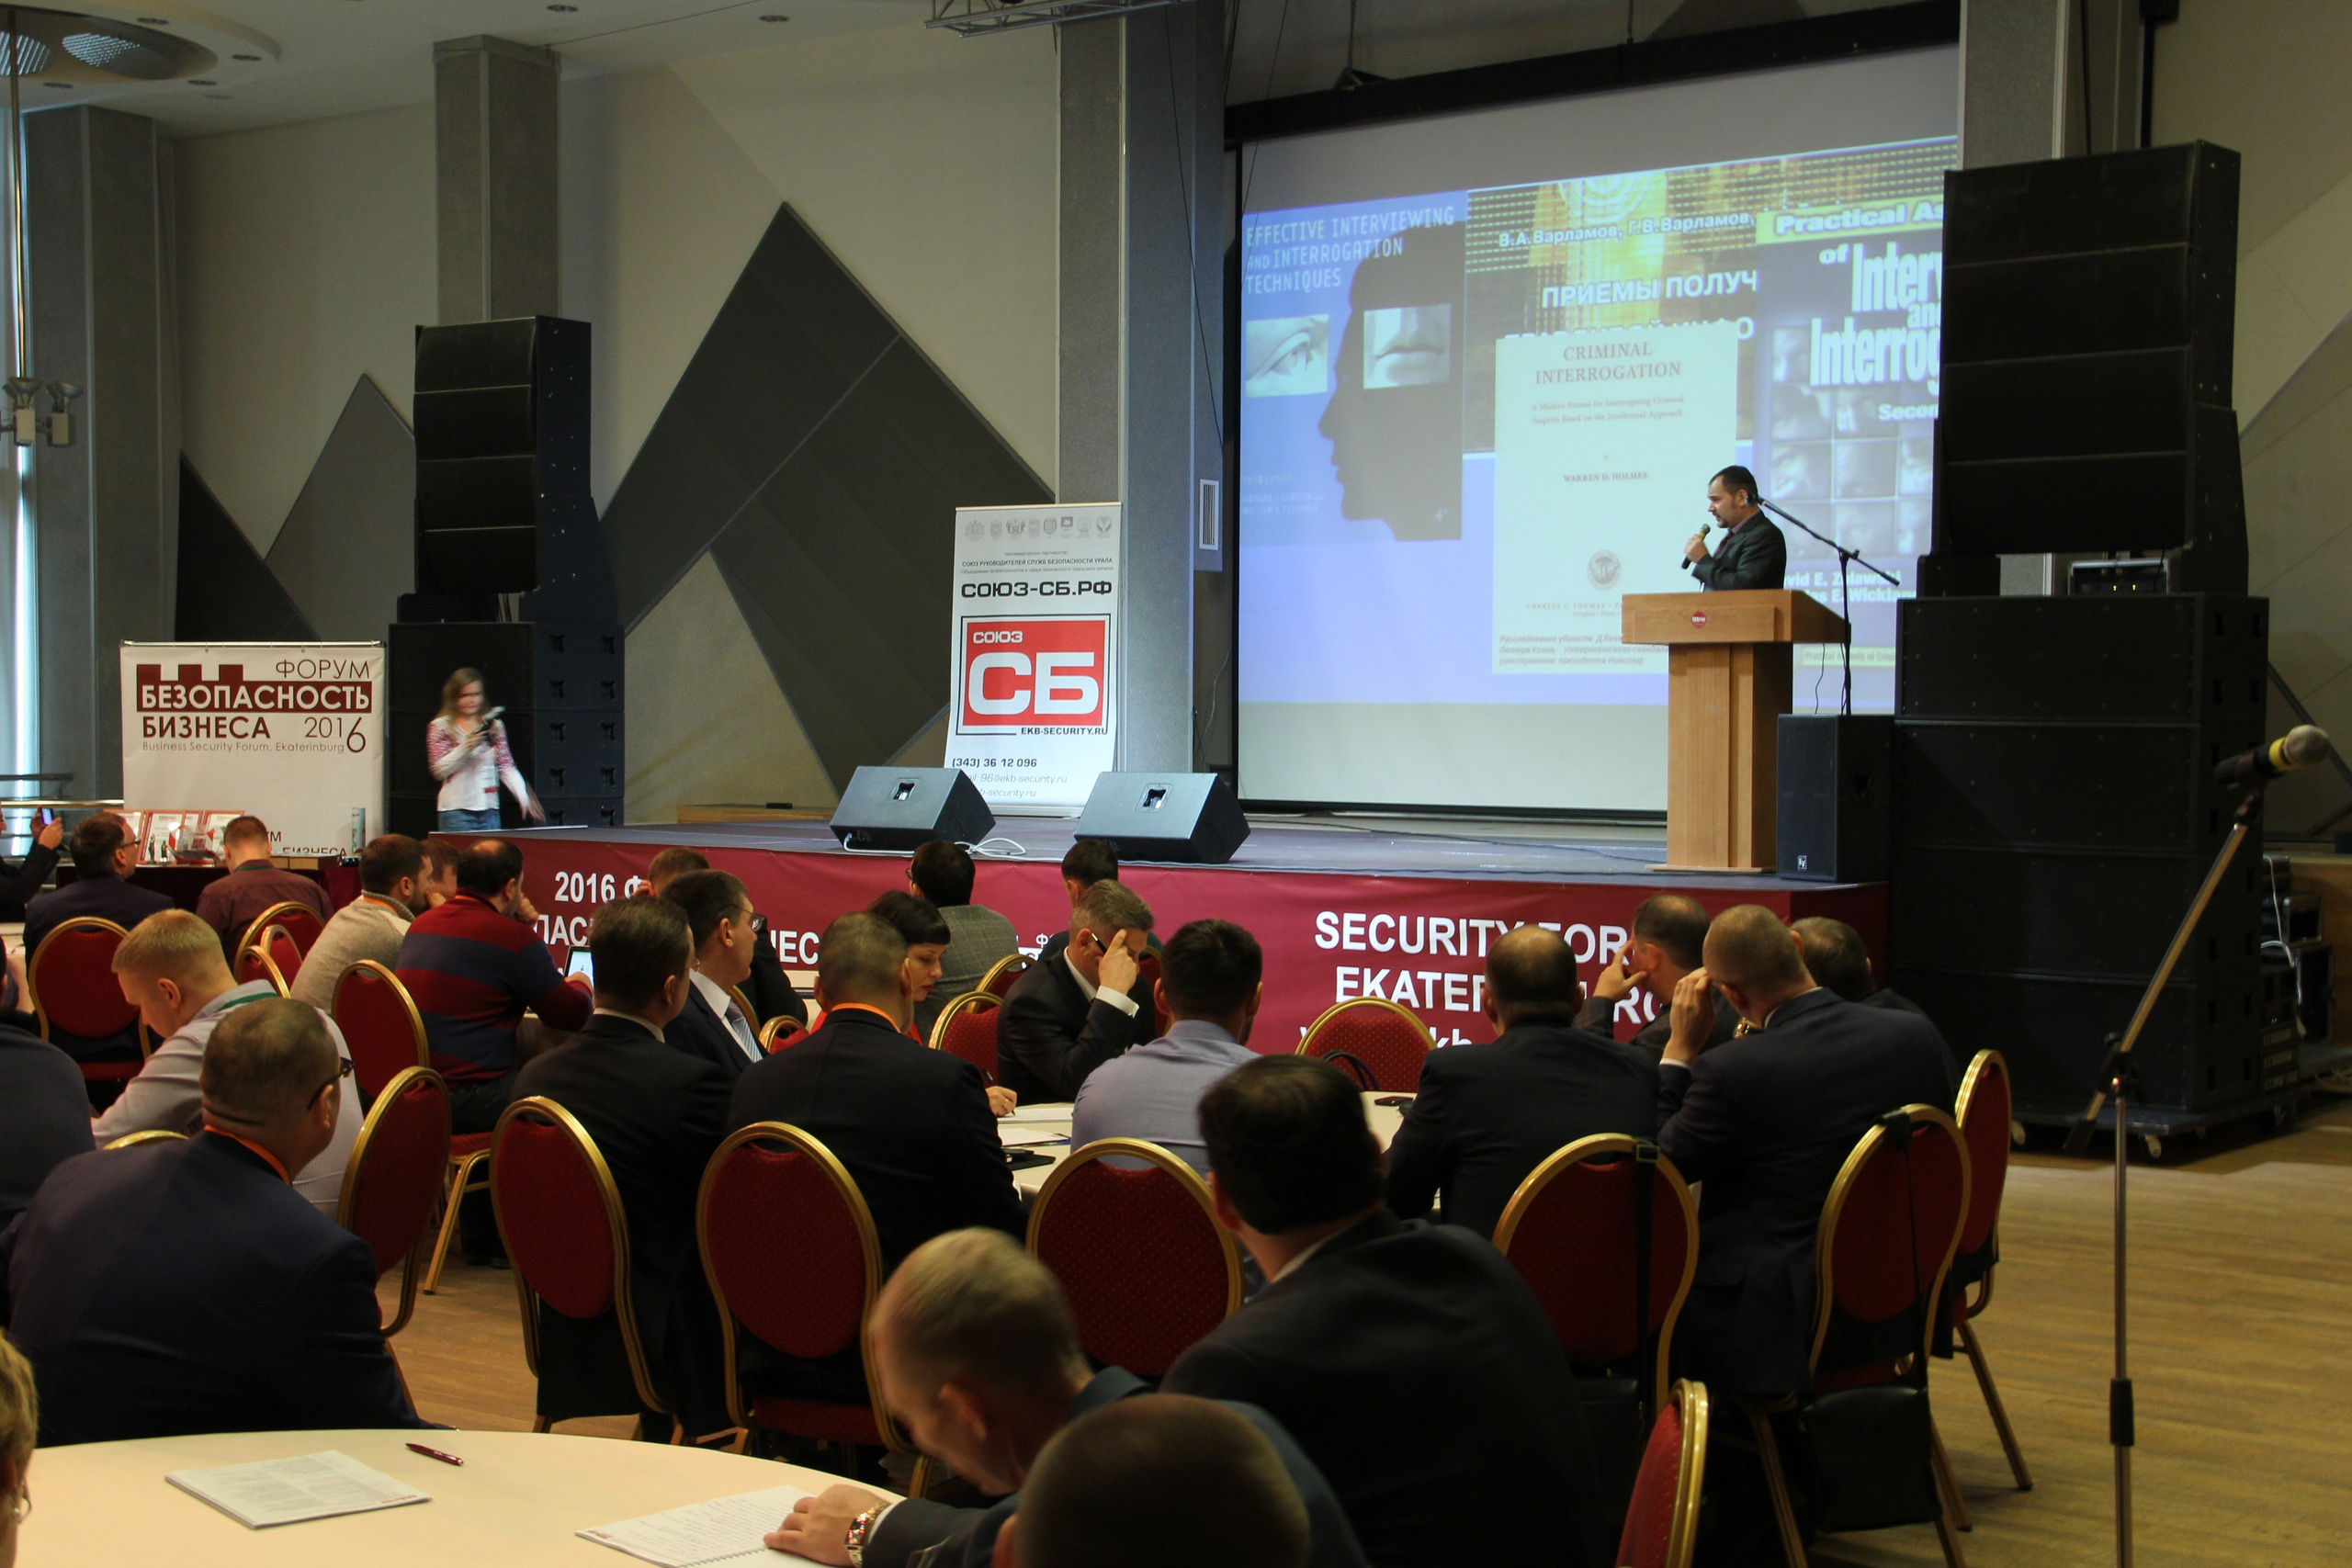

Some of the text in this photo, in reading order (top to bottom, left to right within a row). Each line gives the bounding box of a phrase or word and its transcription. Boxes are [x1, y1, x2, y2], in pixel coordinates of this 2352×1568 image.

[1246, 207, 1454, 247] EFFECTIVE INTERVIEWING
[1776, 203, 1907, 234] Practical
[1247, 238, 1403, 270] AND INTERROGATION
[1819, 243, 1849, 265] of
[1246, 268, 1341, 295] TECHNIQUES
[1542, 278, 1660, 309] ПРИЕМЫ
[1563, 341, 1653, 361] CRIMINAL
[1535, 362, 1681, 385] INTERROGATION
[1564, 473, 1599, 483] WARREN
[1611, 471, 1648, 480] HOLMES
[961, 581, 1113, 598] СОЮЗ-СБ.РФ
[972, 630, 1023, 644] СОЮЗ
[276, 659, 370, 679] ФОРУМ
[967, 651, 1100, 716] СБ
[141, 684, 370, 710] БЕЗОПАСНОСТЬ
[143, 716, 367, 753] БИЗНЕСА 2016
[1021, 727, 1108, 736] EKB-SECURITY.RU
[142, 741, 345, 753] Business Security Forum, Ekaterinburg
[952, 758, 1037, 768] (343) 36 12 096
[979, 773, 1068, 785] 96@ekb-security.ru
[979, 788, 1036, 799] b-security.ru
[555, 871, 616, 903] 2016
